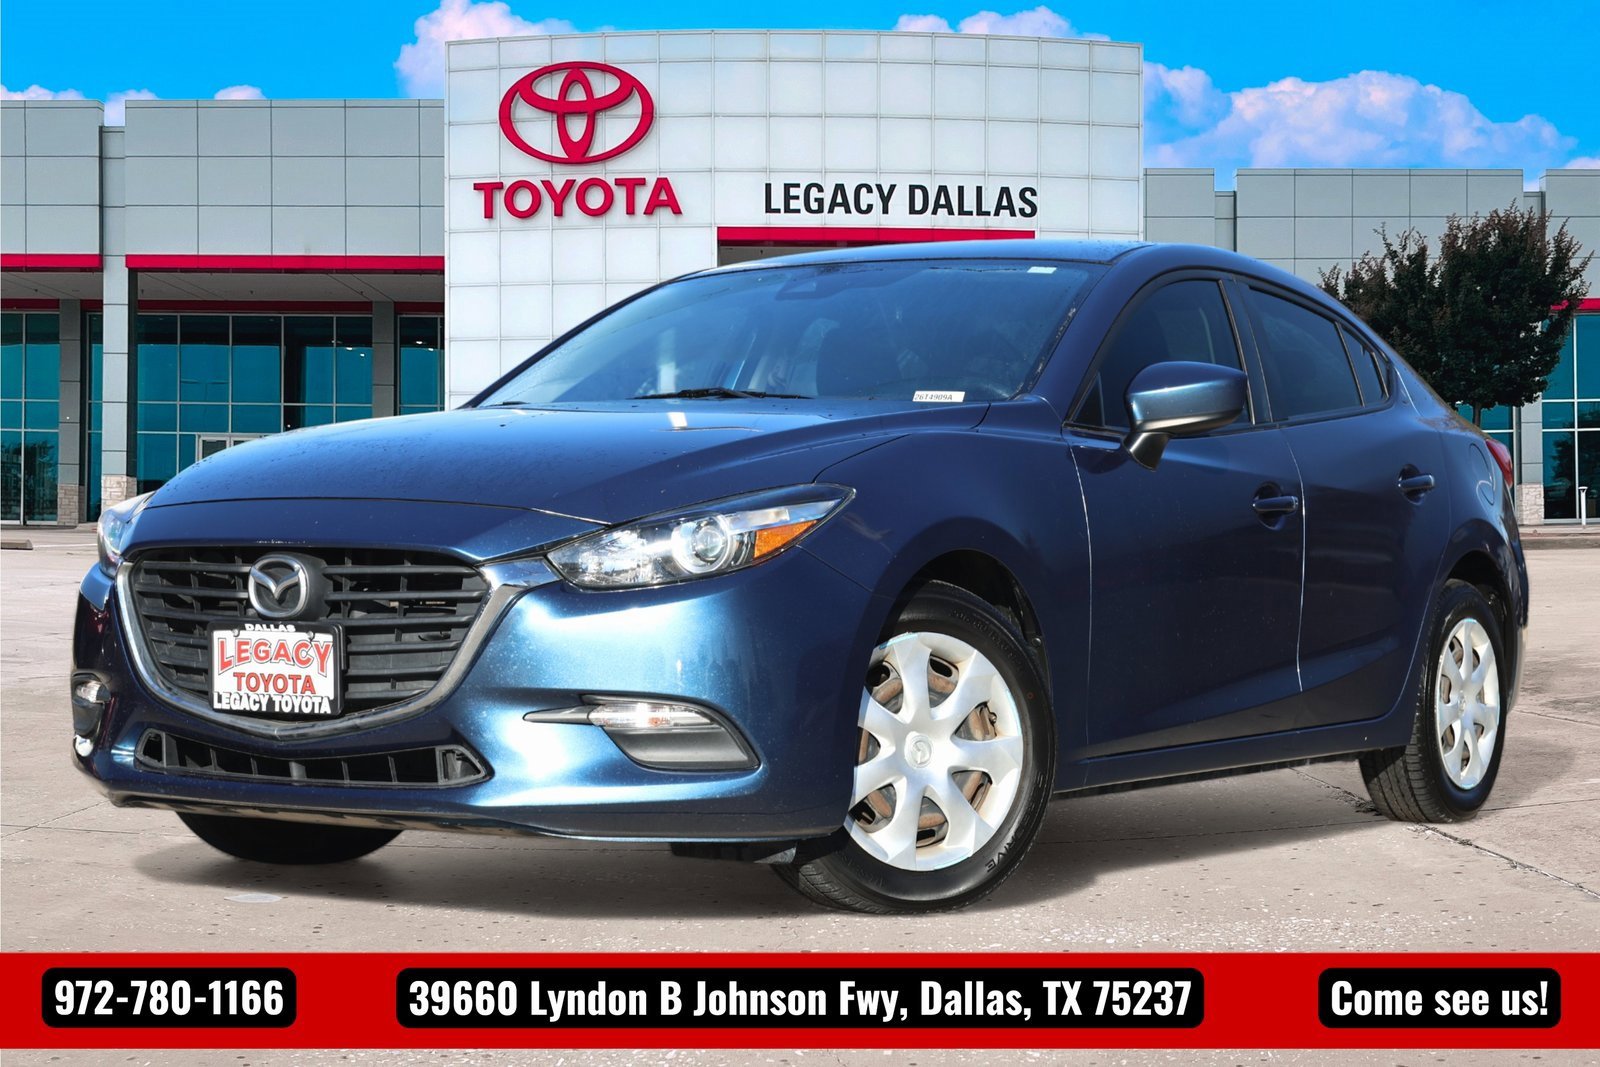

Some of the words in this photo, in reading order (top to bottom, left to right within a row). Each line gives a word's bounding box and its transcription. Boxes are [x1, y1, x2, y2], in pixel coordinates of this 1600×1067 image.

[473, 177, 683, 219] TOYOTA
[764, 182, 897, 214] LEGACY
[908, 184, 1038, 218] DALLAS
[245, 623, 296, 632] DALLAS
[218, 638, 333, 678] LEGACY
[233, 672, 316, 694] TOYOTA
[213, 692, 270, 711] LEGACY
[272, 695, 331, 714] TOYOTA
